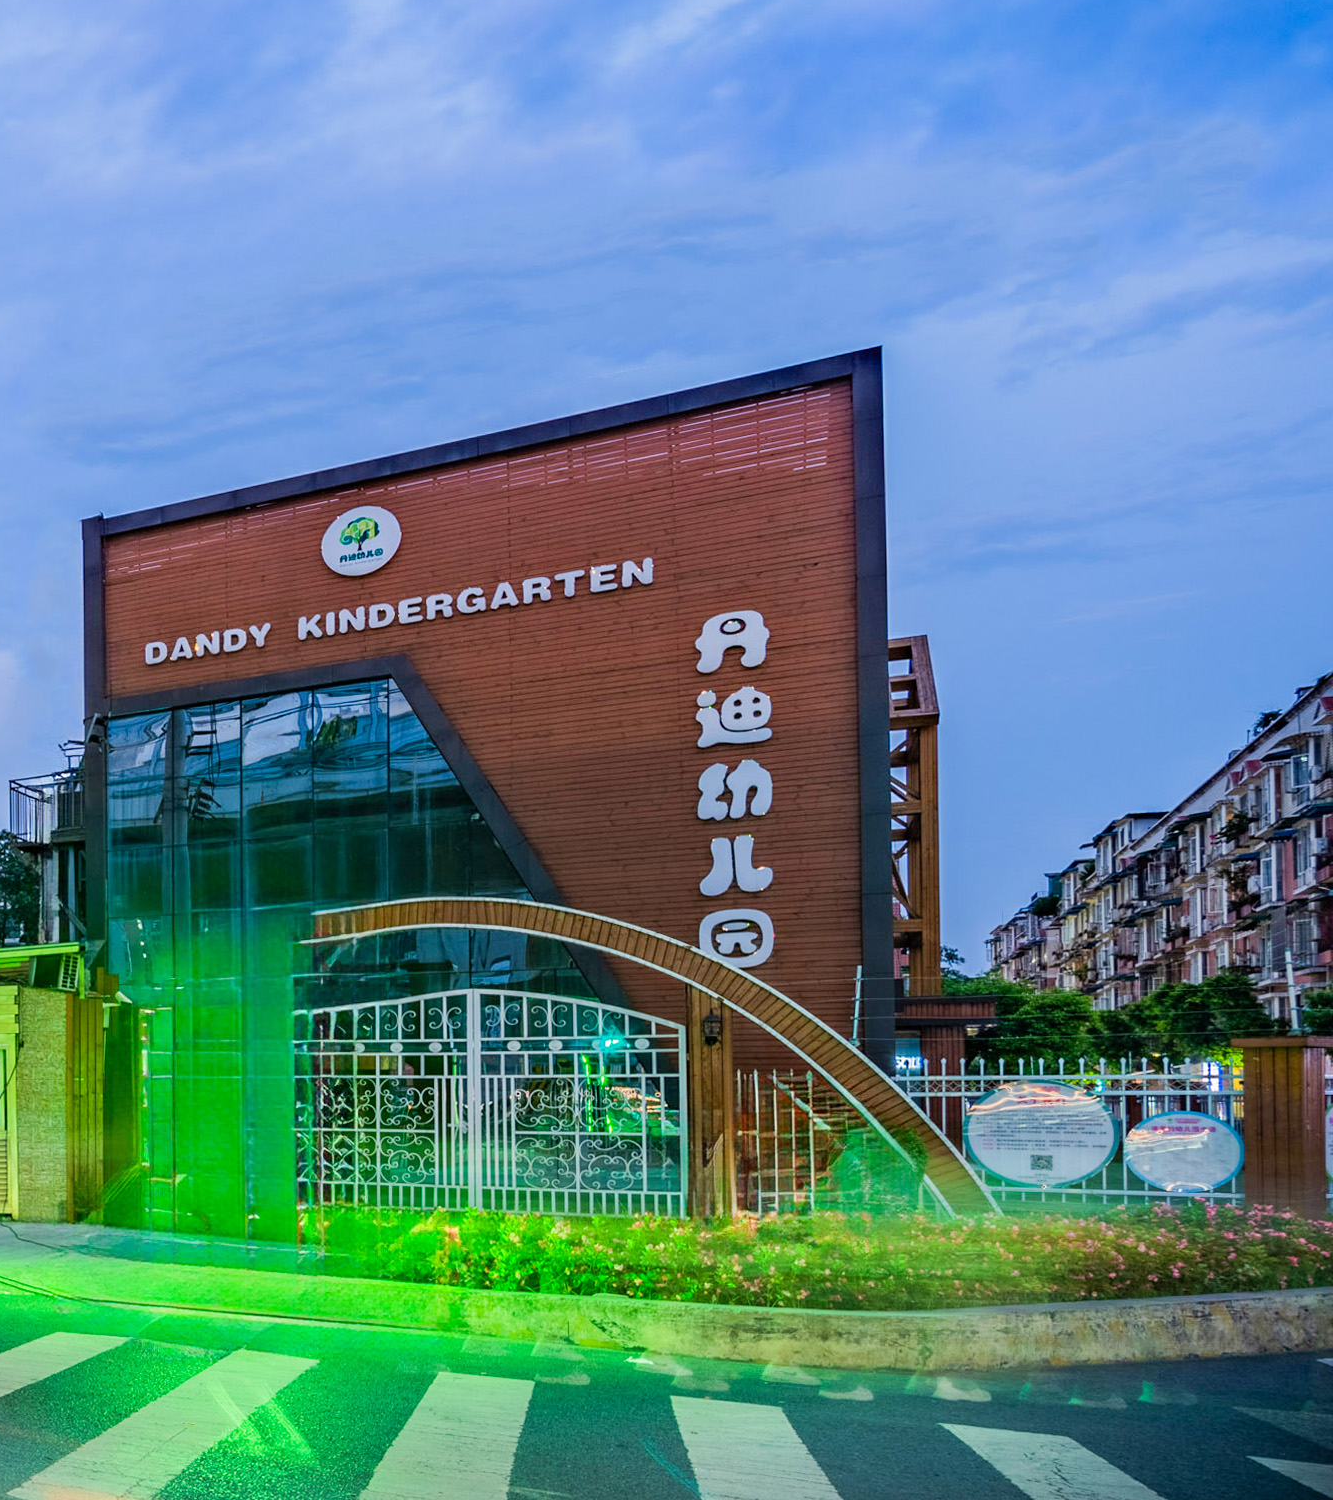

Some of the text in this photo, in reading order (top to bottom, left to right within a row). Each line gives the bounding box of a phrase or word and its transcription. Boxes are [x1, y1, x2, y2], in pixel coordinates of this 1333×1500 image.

[144, 557, 654, 666] DANDY KINDERGARTEN
[694, 609, 776, 969] 丹迪幼儿园
